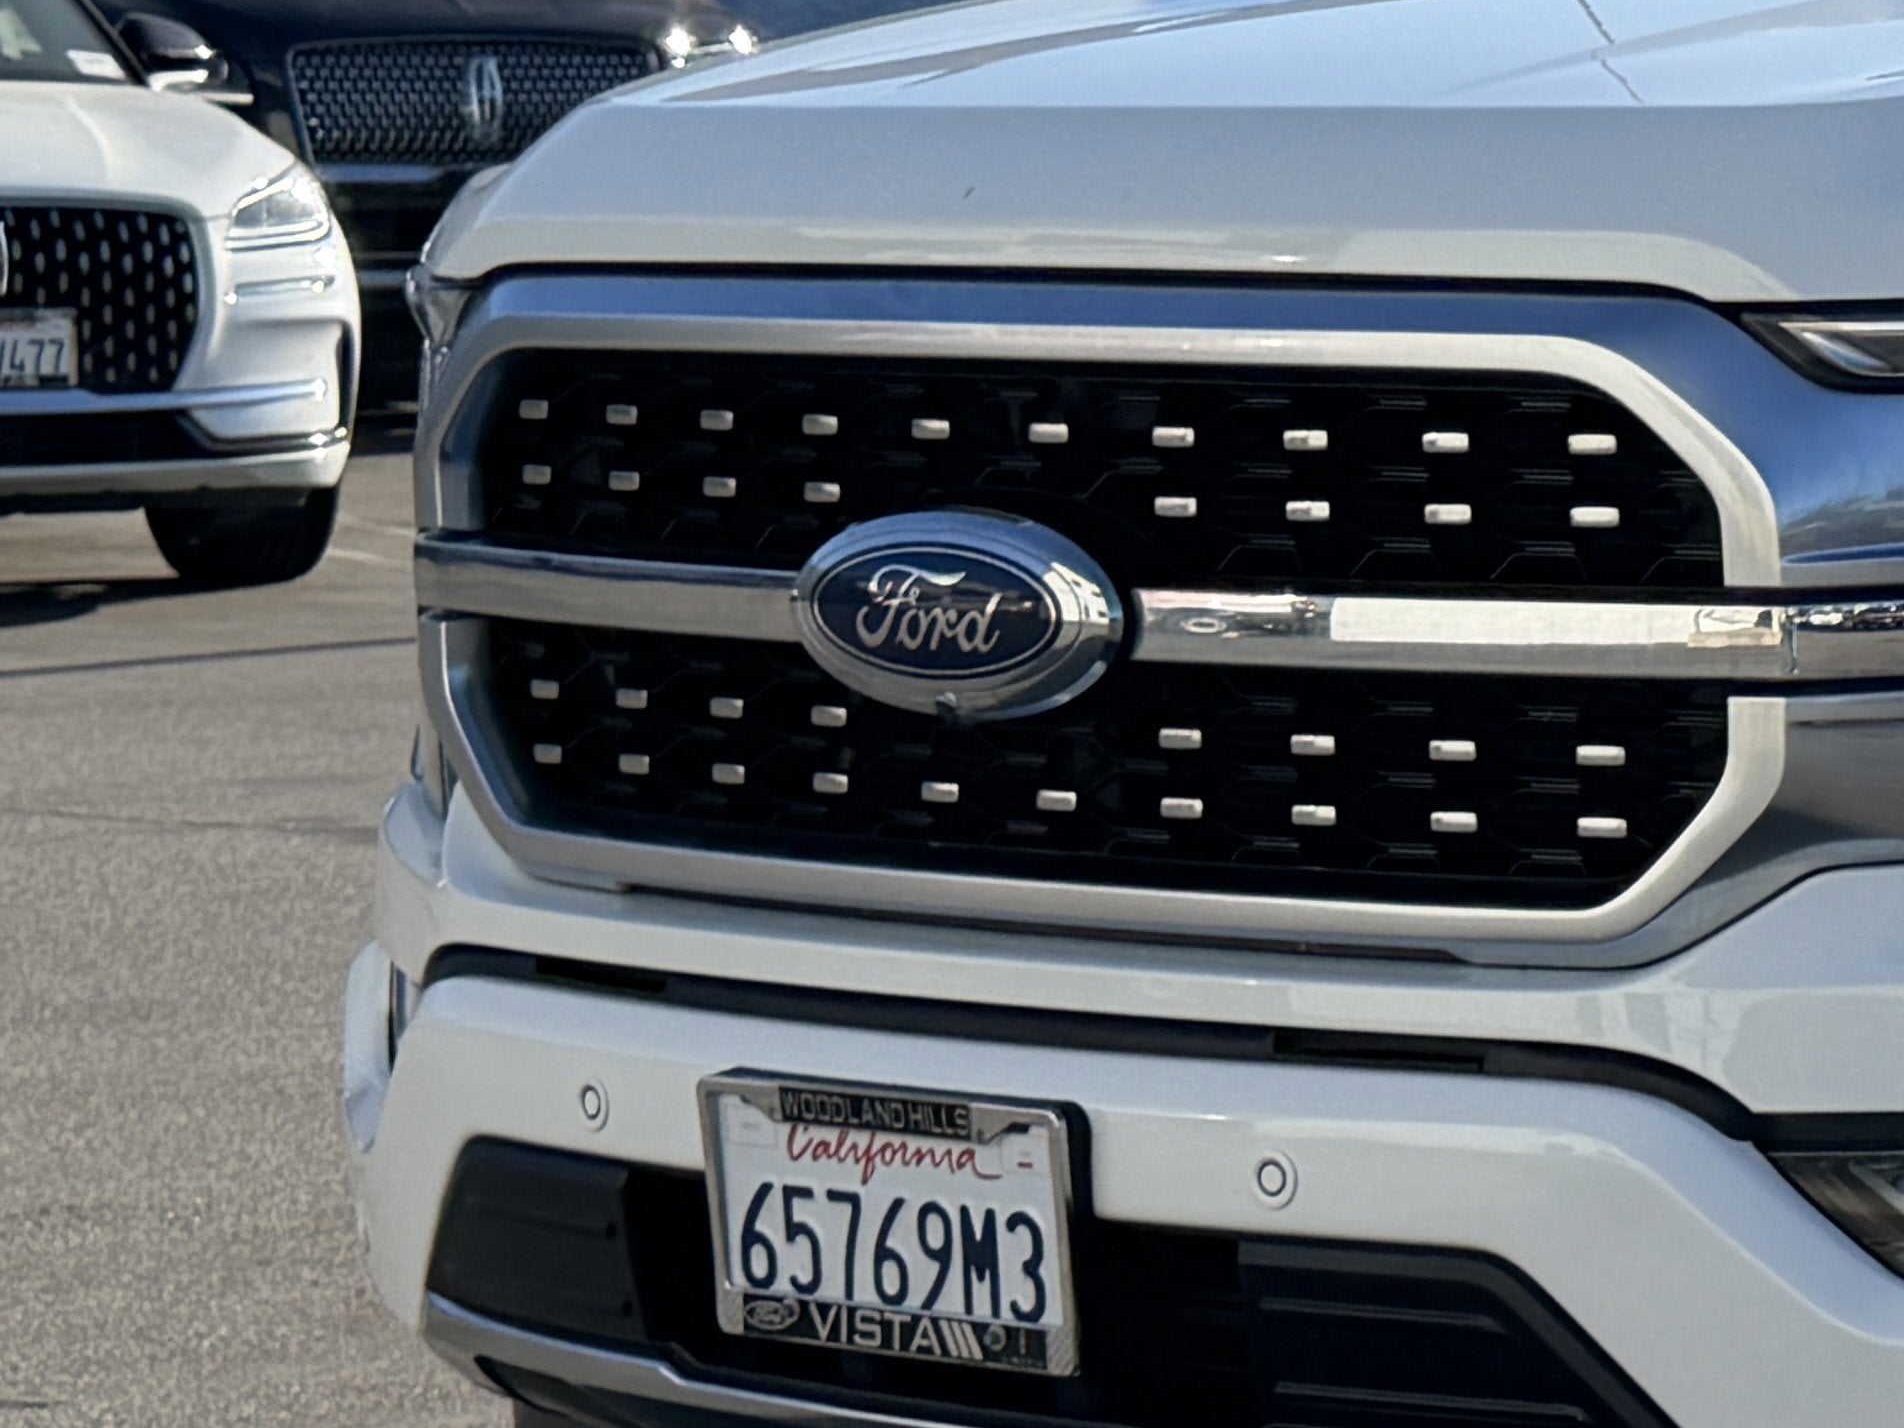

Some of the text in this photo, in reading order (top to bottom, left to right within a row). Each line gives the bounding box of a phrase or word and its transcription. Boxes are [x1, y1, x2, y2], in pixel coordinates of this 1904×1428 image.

[855, 563, 1003, 654] Ford
[781, 1087, 971, 1137] WOODLAND HILLS
[786, 1123, 1003, 1185] California
[740, 1181, 1047, 1324] 65769M3
[809, 1302, 942, 1357] VISTA
